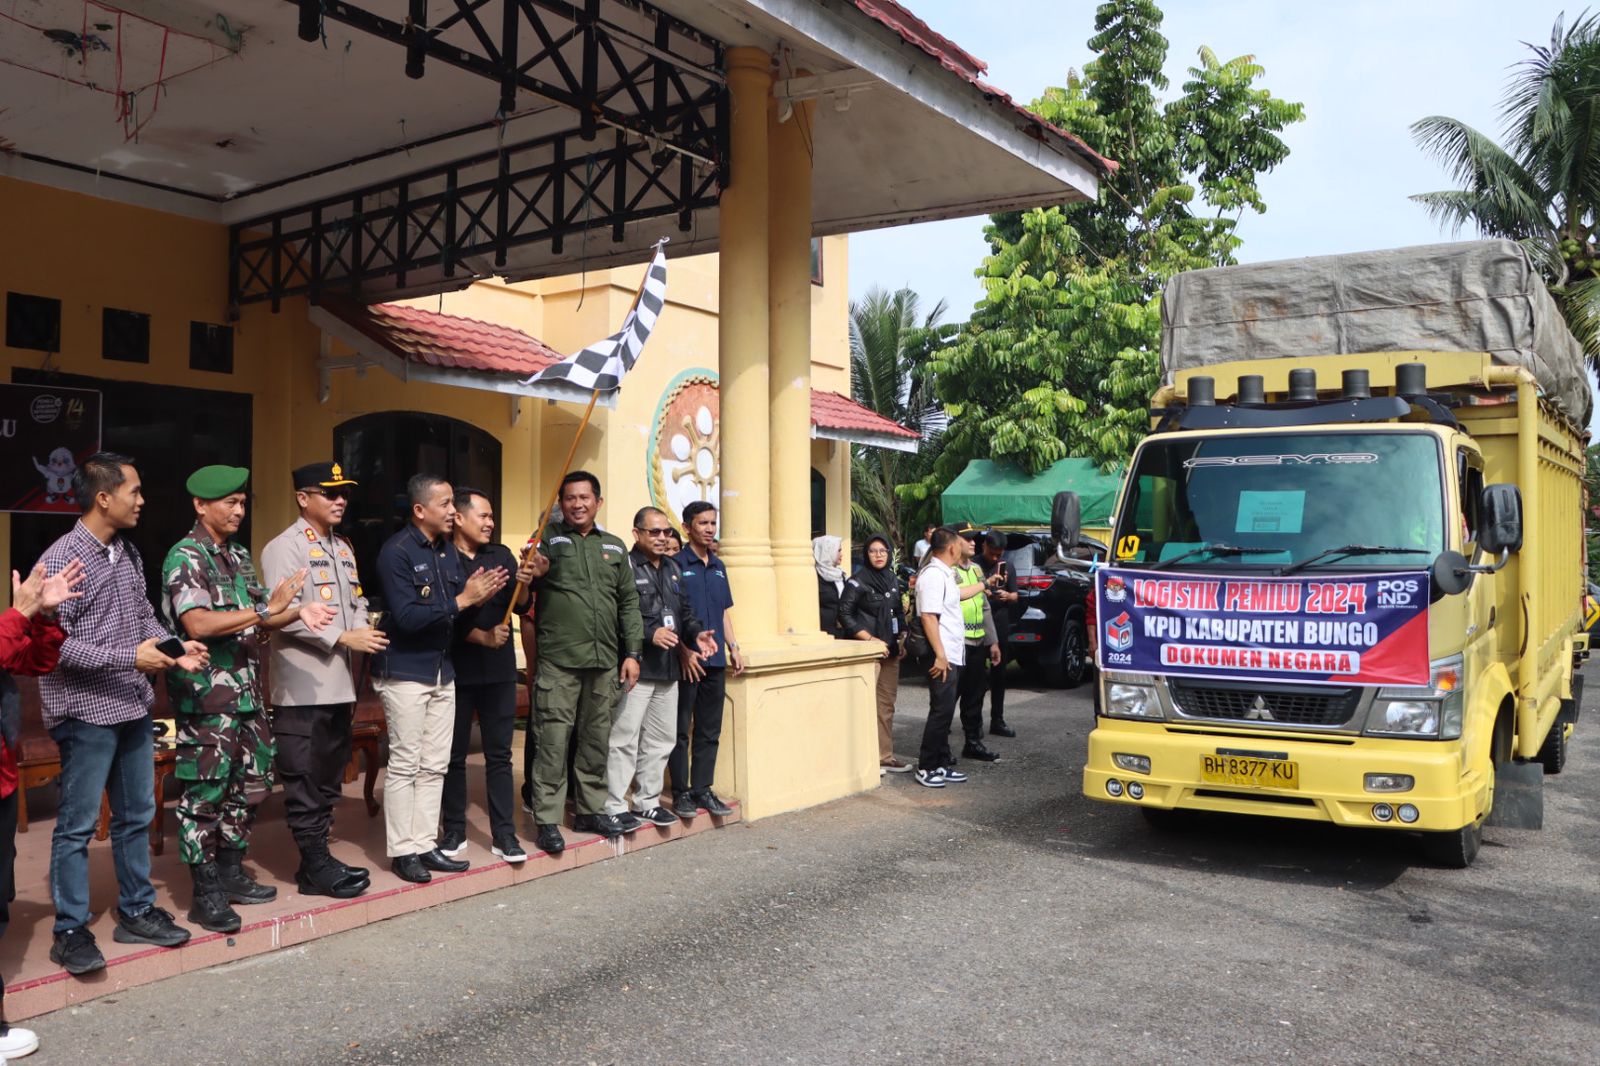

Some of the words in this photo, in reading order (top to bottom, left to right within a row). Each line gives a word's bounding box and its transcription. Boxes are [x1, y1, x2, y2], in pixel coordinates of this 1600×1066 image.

[1134, 579, 1220, 611] LOGISTIK
[1224, 582, 1301, 613] PEMILU
[1305, 582, 1367, 614] 2024
[1377, 580, 1419, 593] POS
[1144, 615, 1181, 639] KPU
[1185, 617, 1299, 644] KABUPATEN
[1304, 621, 1378, 646] BUNGO
[1108, 652, 1132, 661] 2024
[1167, 646, 1262, 668] DOKUMEN
[1268, 651, 1352, 672] NEGARA
[1204, 757, 1225, 774] BH
[1229, 759, 1268, 776] 8377
[1272, 762, 1294, 780] KU
